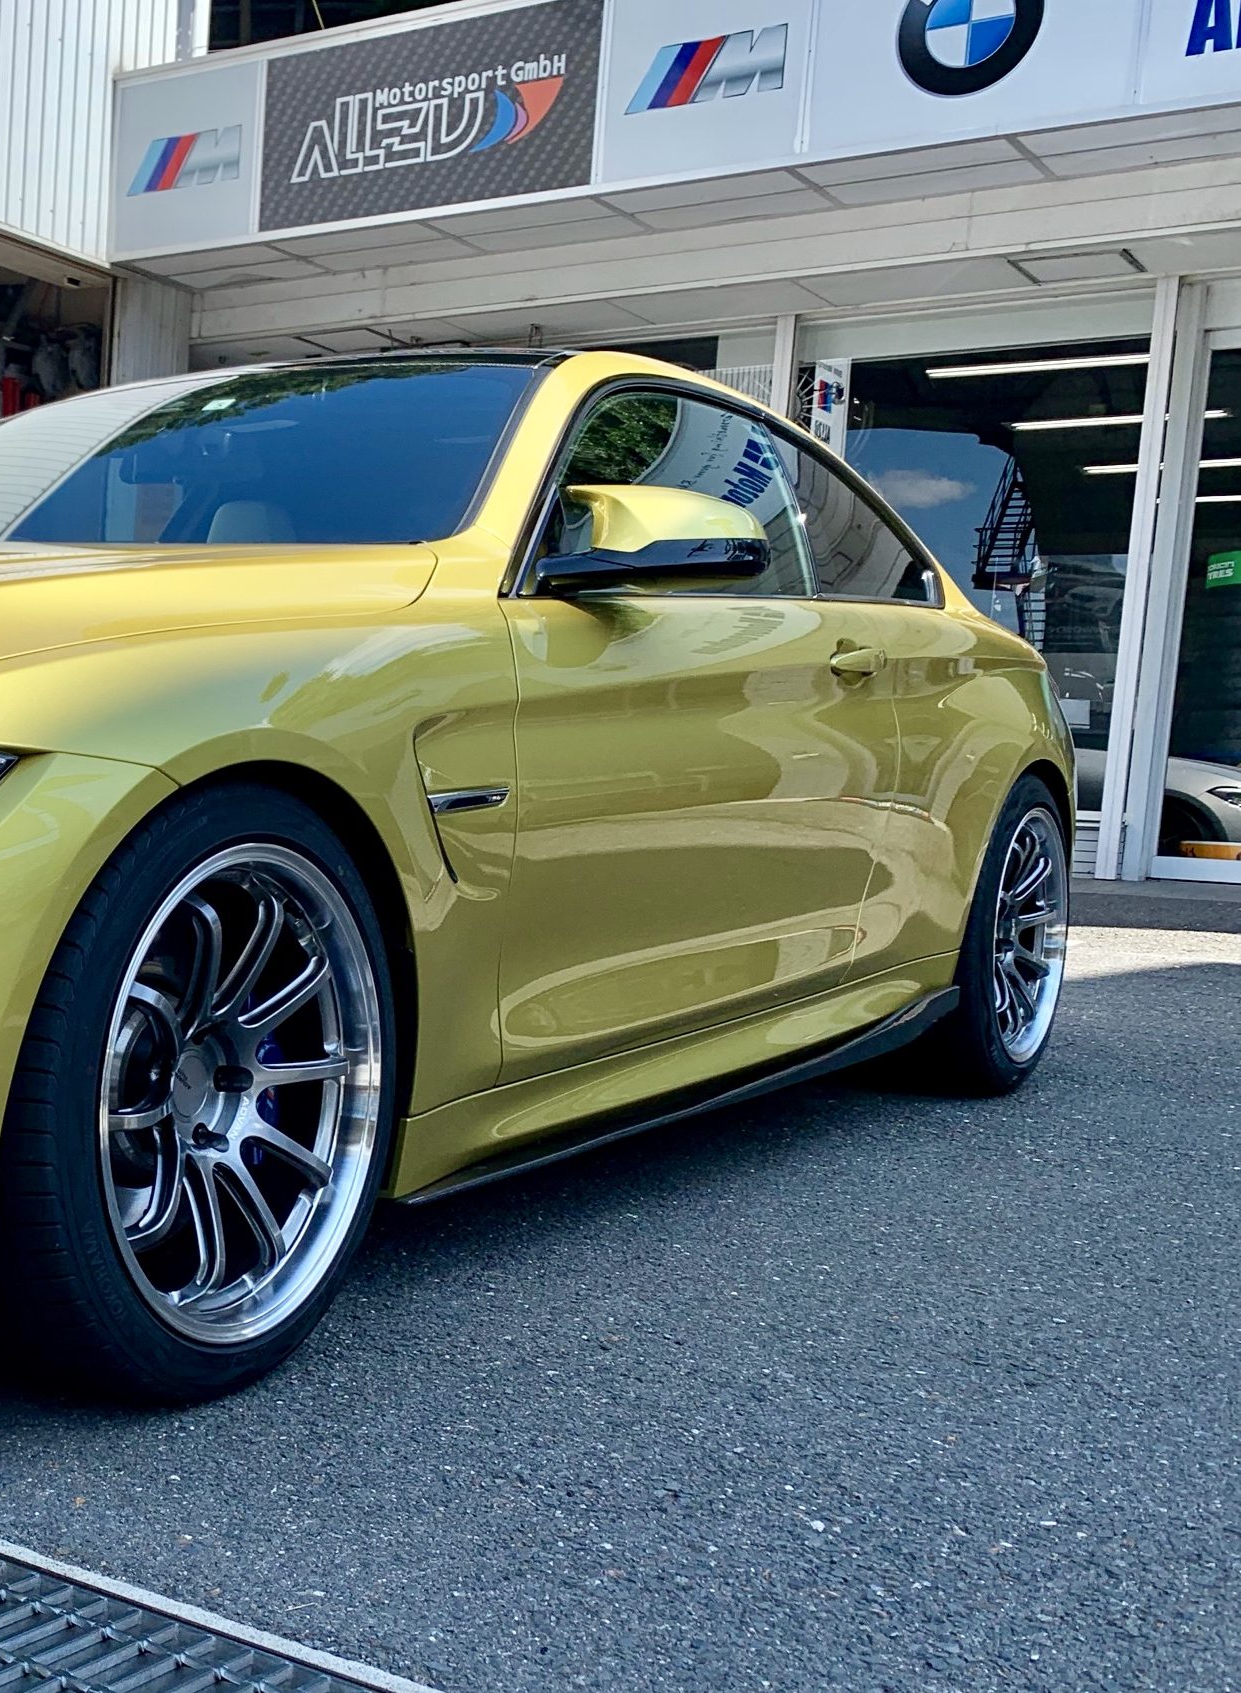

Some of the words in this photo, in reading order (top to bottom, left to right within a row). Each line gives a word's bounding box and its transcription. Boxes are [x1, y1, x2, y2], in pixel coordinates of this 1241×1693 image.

[1185, 0, 1241, 57] A
[375, 65, 507, 108] Motorsport
[510, 53, 567, 83] GmbH
[229, 1096, 250, 1140] ADVAN
